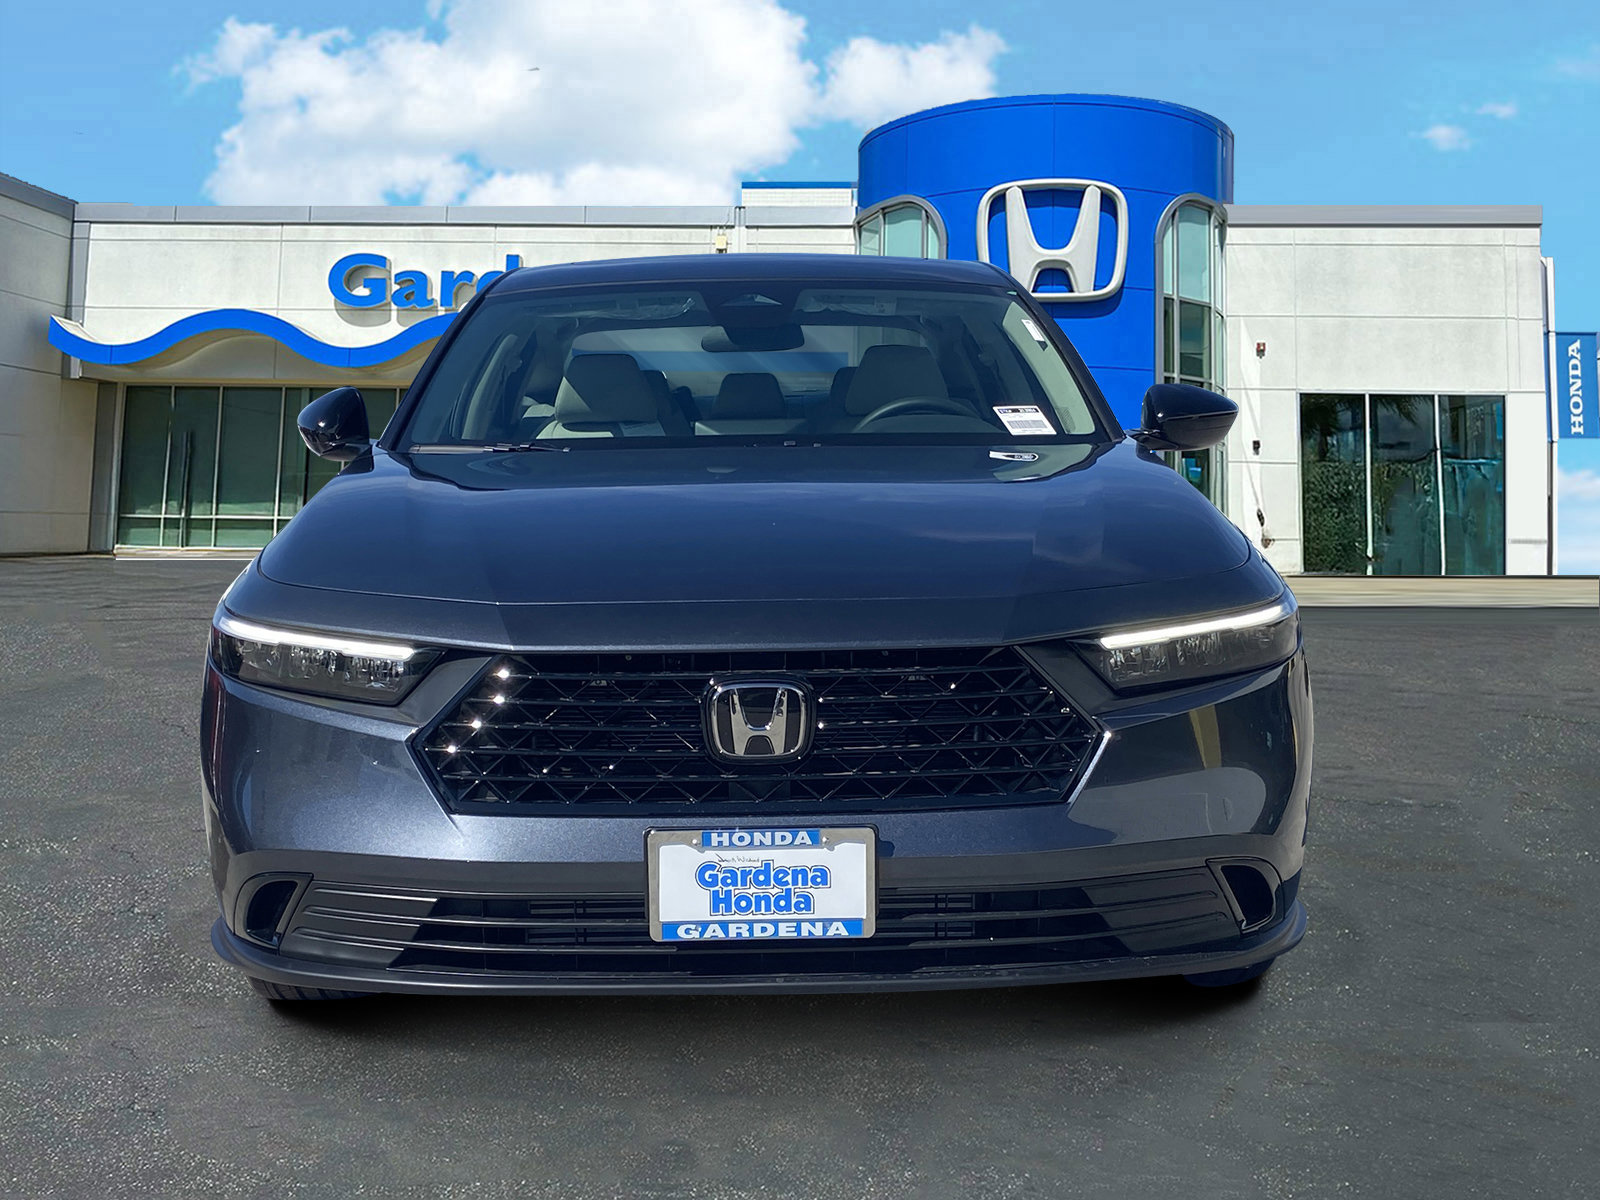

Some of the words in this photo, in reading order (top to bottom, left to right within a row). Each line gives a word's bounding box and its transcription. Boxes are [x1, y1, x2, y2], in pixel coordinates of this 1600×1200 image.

[1568, 339, 1584, 435] HONDA
[710, 831, 813, 847] HONDA
[696, 861, 830, 889] Gardena
[711, 888, 813, 915] Honda
[676, 921, 850, 939] GARDENA
